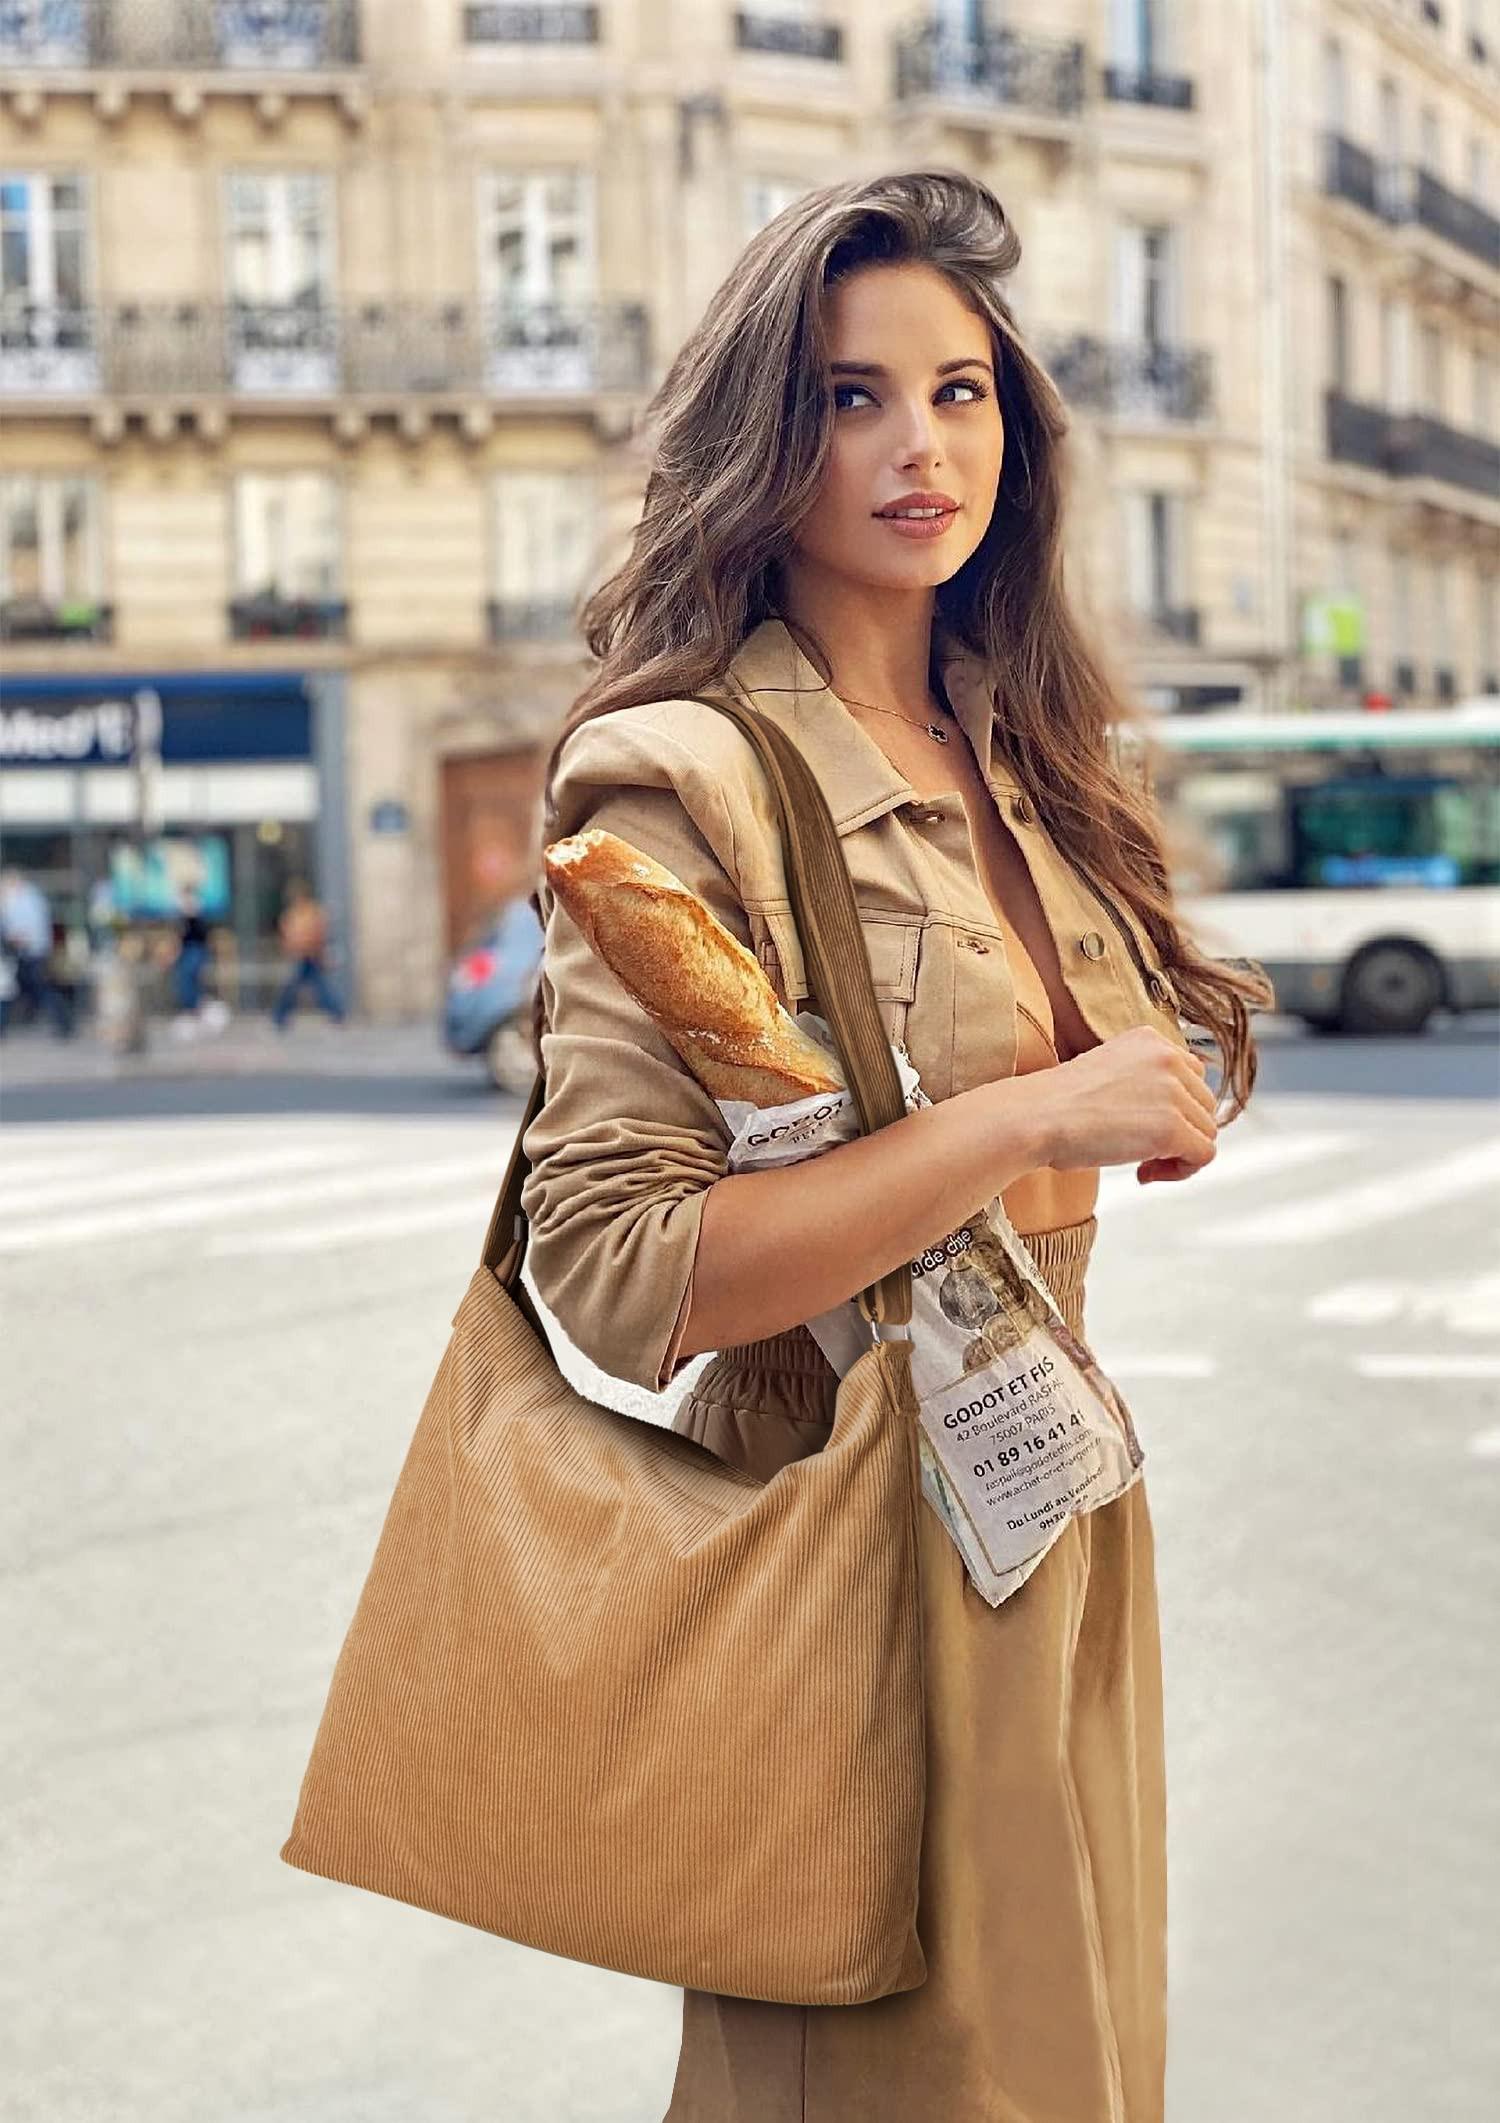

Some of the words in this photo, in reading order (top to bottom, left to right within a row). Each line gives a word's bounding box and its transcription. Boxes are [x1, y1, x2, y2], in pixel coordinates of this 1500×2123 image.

[924, 1249, 943, 1268] de
[944, 1387, 1004, 1428] GODOT
[1008, 1374, 1028, 1396] ET
[957, 1430, 970, 1442] 42
[972, 1400, 1027, 1436] Boulevard
[974, 1460, 995, 1477] 01
[998, 1447, 1020, 1466] 89
[1023, 1436, 1045, 1453] 16
[1048, 1422, 1066, 1440] 41
[1069, 1409, 1085, 1426] 41
[989, 1422, 1023, 1445] 75007
[1024, 1404, 1056, 1428] PARIS
[1007, 1520, 1024, 1530] Du
[1024, 1501, 1054, 1520] Lundi
[1056, 1495, 1068, 1506] au
